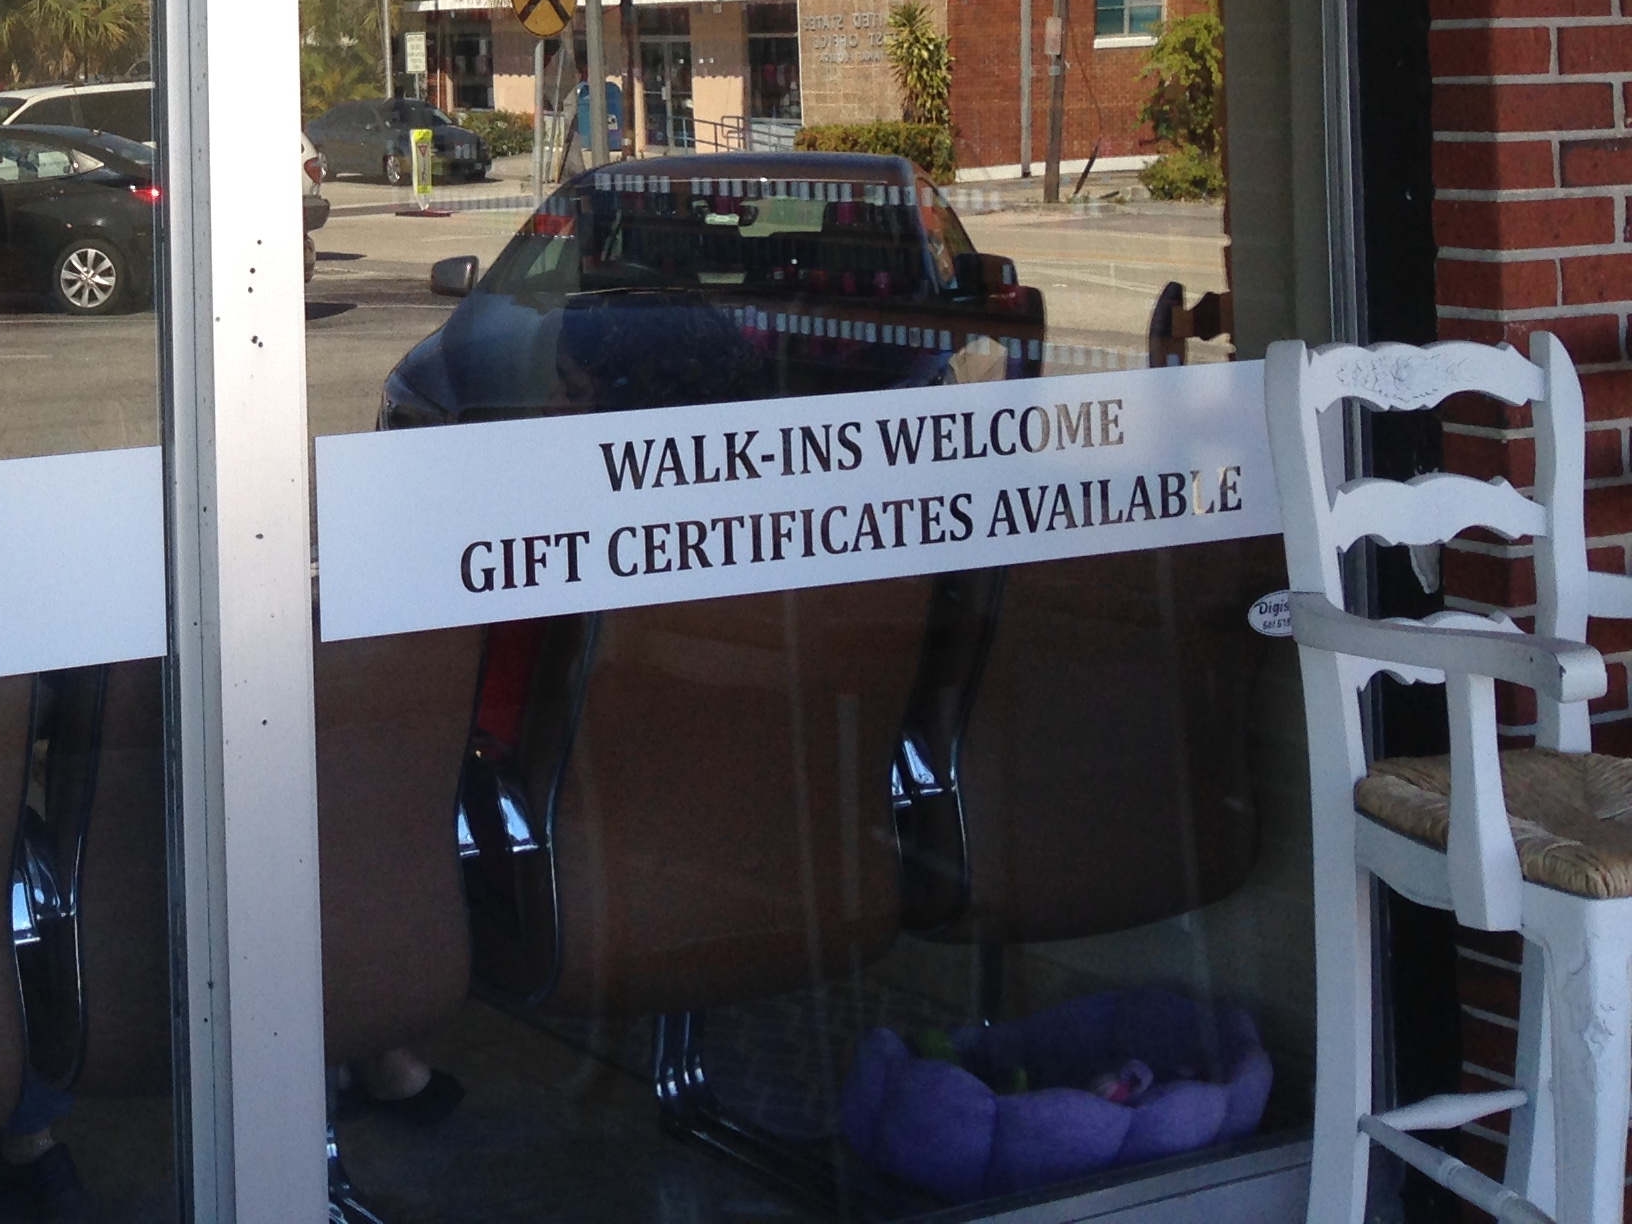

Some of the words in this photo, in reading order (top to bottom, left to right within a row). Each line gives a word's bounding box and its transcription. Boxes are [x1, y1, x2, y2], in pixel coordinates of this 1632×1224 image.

[599, 421, 862, 492] WALK-INS
[876, 398, 1125, 466] WELCOME
[460, 531, 590, 593] GIFT
[608, 492, 974, 578] CERTIFICATES
[987, 465, 1242, 538] AVAILABLE
